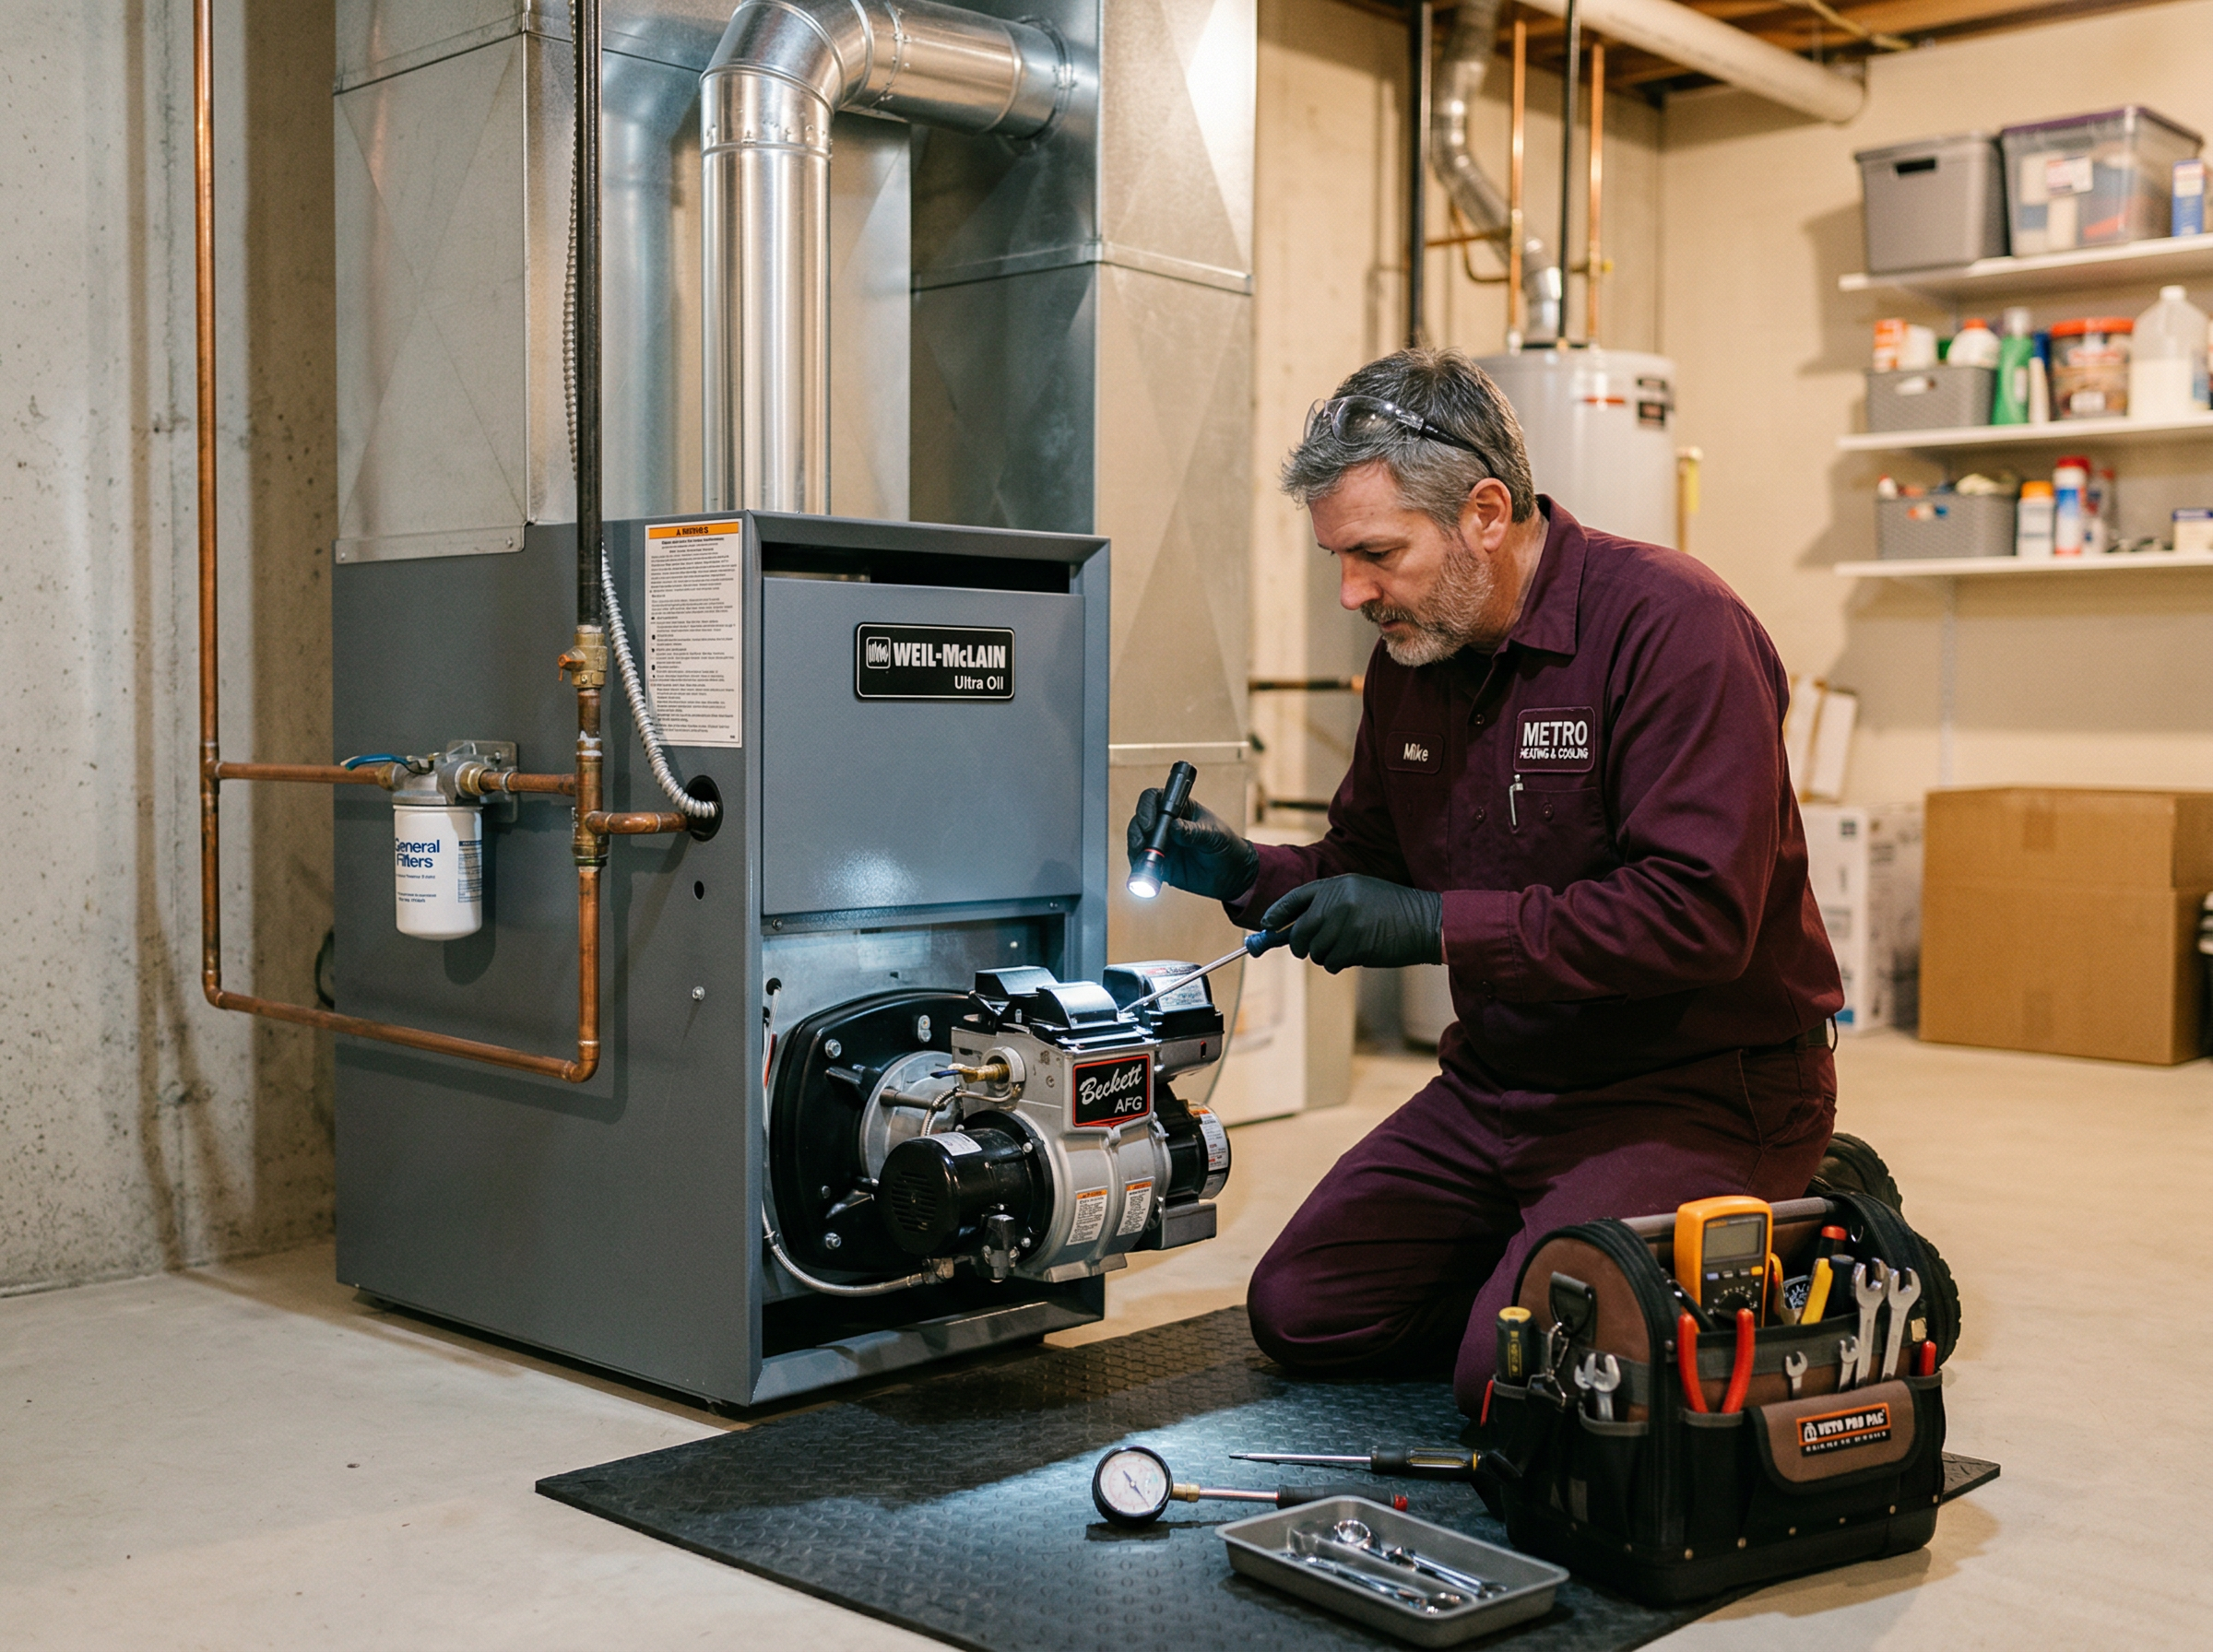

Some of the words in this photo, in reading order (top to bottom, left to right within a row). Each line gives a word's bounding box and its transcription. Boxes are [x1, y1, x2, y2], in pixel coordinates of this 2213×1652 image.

[893, 642, 1006, 669] WEIL-McLAIN
[954, 675, 984, 690] Ultra
[1522, 720, 1588, 747] METRO
[1402, 742, 1428, 762] Mike
[1520, 748, 1549, 760] HEATING
[1550, 748, 1556, 759] &
[1557, 748, 1589, 760] COOLING
[1079, 1063, 1142, 1105] Beckett
[1114, 1096, 1142, 1114] AFG
